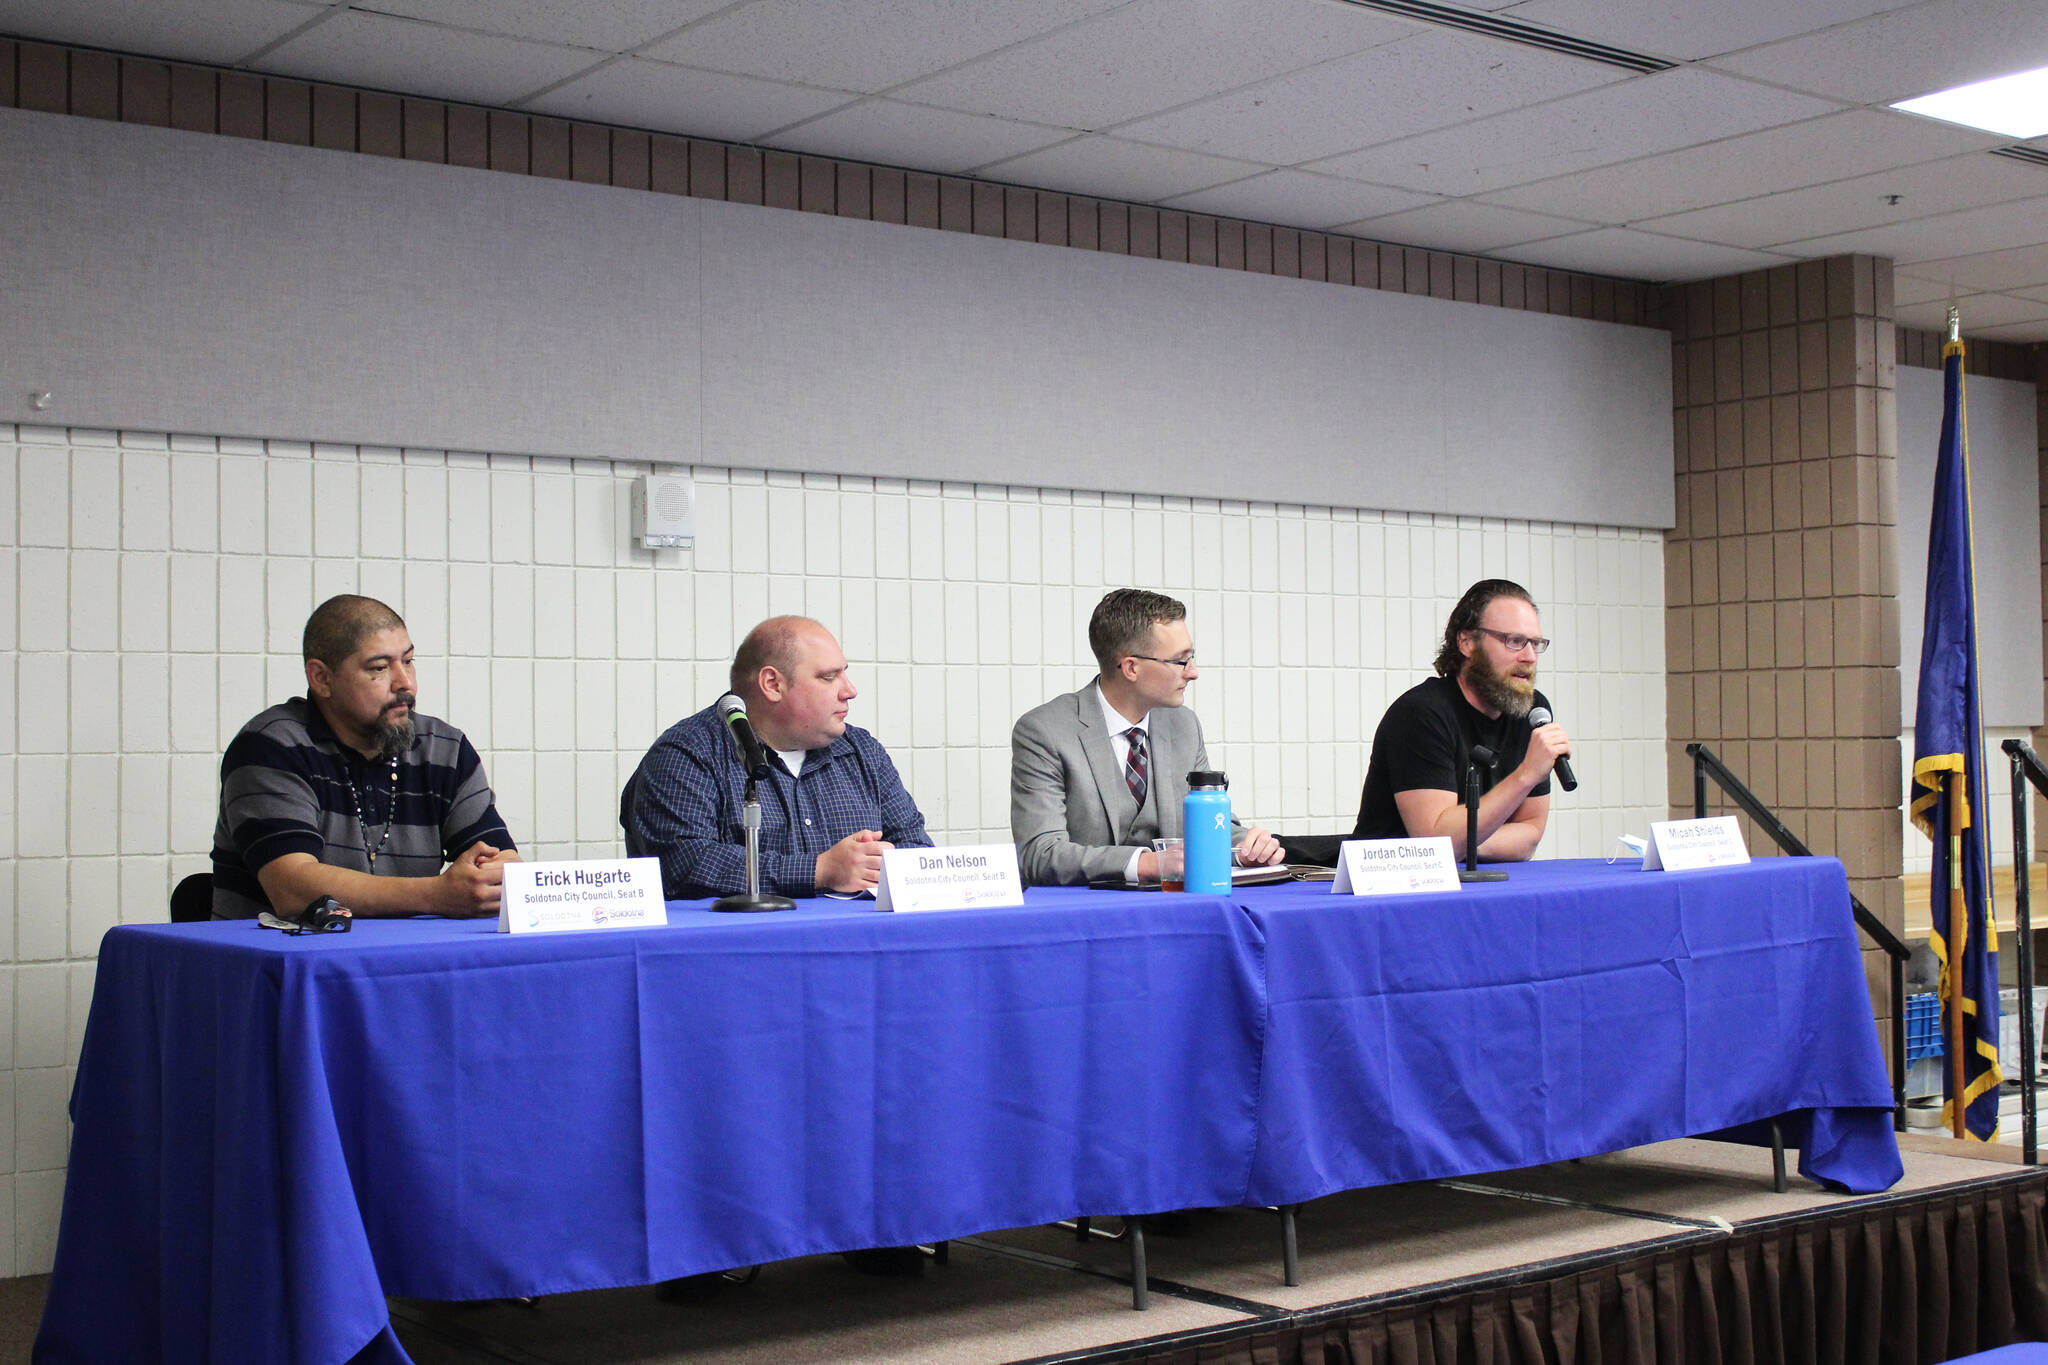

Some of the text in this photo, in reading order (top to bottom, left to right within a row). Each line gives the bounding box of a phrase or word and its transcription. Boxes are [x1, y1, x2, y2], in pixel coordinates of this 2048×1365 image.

[1668, 824, 1725, 839] Micah Shields
[1362, 845, 1435, 860] Jordan Chilson
[919, 854, 987, 870] Dan Nelson
[535, 868, 632, 888] Erick Hugarte
[904, 876, 937, 886] Soldotna
[938, 875, 951, 885] City
[983, 872, 999, 881] Seat
[524, 893, 562, 904] Soldotna
[564, 892, 580, 903] City
[618, 888, 636, 899] Seat
